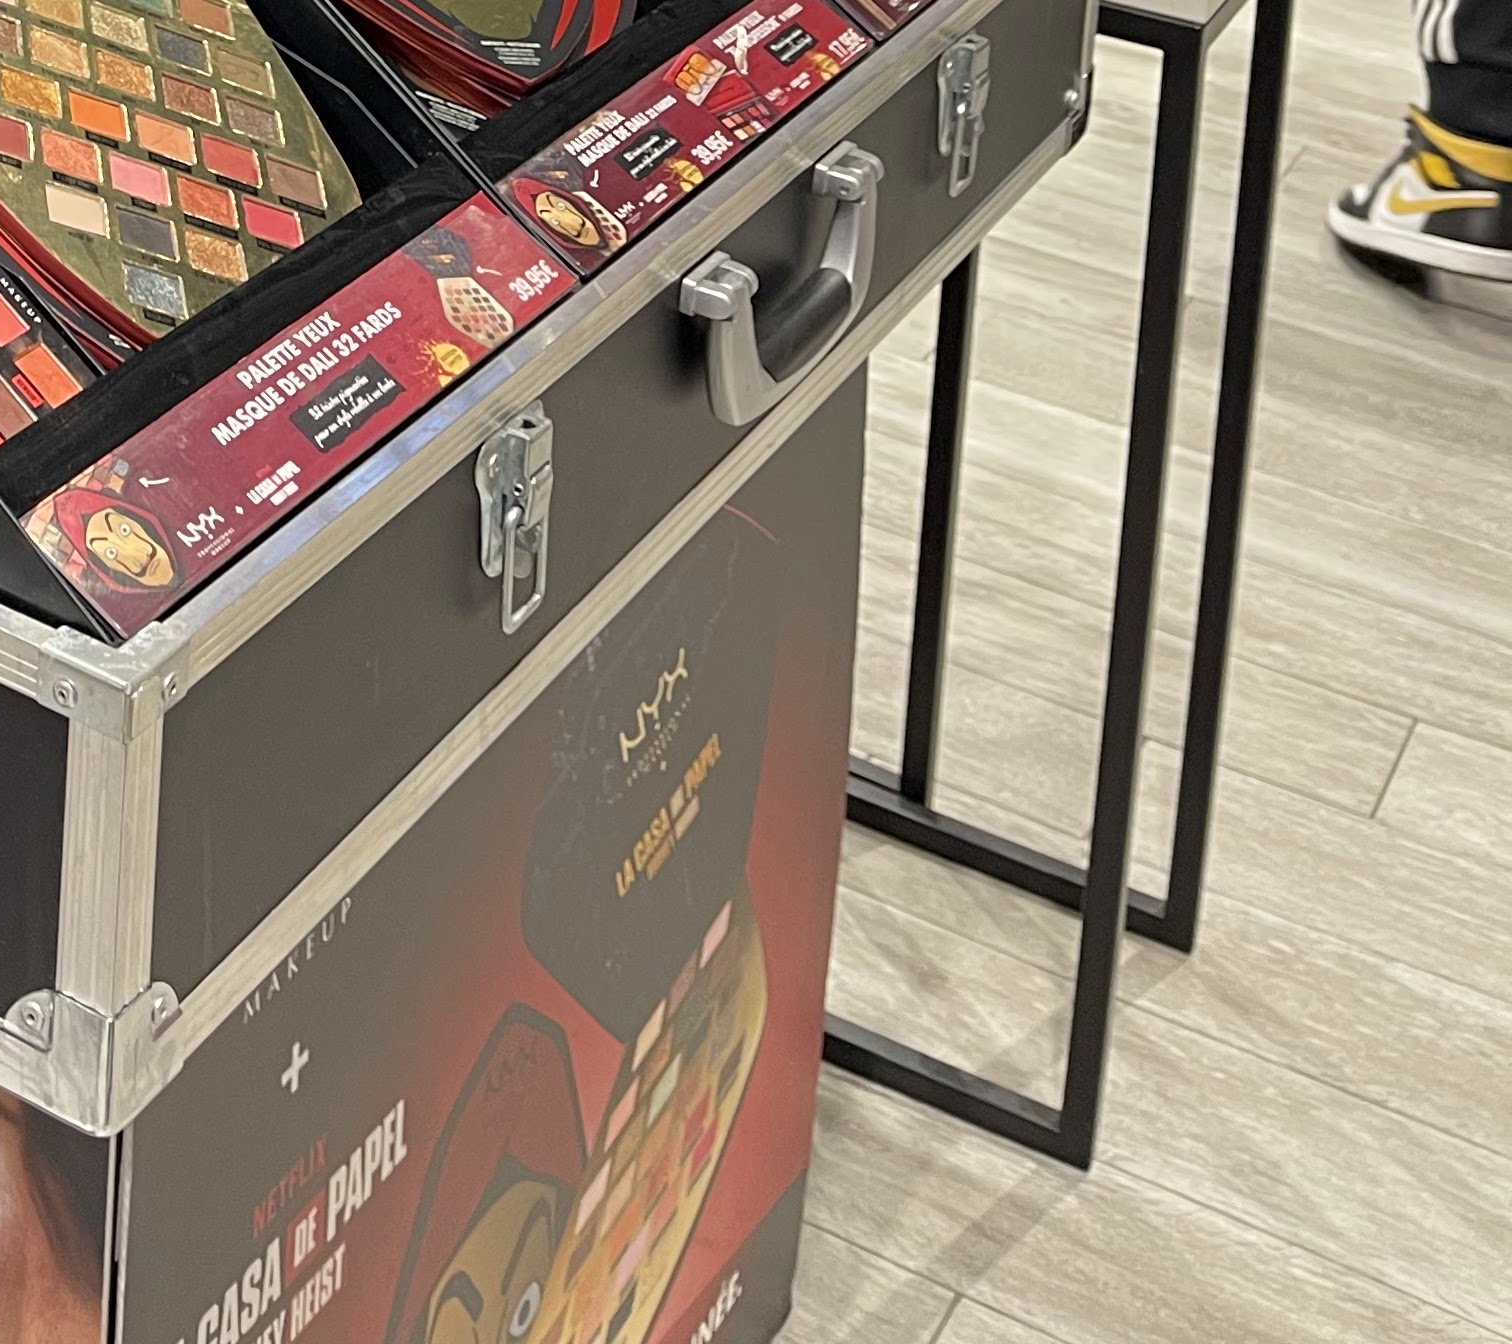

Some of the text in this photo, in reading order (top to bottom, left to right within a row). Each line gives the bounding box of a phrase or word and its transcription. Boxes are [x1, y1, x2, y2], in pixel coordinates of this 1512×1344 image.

[563, 125, 604, 157] PALETTE
[596, 110, 626, 132] YEUX
[577, 133, 621, 168] MASQUE
[613, 125, 632, 141] DE
[624, 112, 651, 133] DALI
[690, 130, 734, 166] 39,95€
[0, 276, 43, 325] MAKEUP
[508, 259, 560, 302] 39,95€
[211, 300, 402, 446] MASQUE DE DALI 32 FARDS
[236, 311, 341, 390] PALETTE YEUX
[176, 506, 225, 548] NYX
[633, 808, 670, 873] CASA
[252, 1137, 327, 1240] NETFLIX
[293, 1206, 318, 1268] DE
[326, 1098, 409, 1242] PAPEL
[290, 1244, 346, 1343] HEIST
